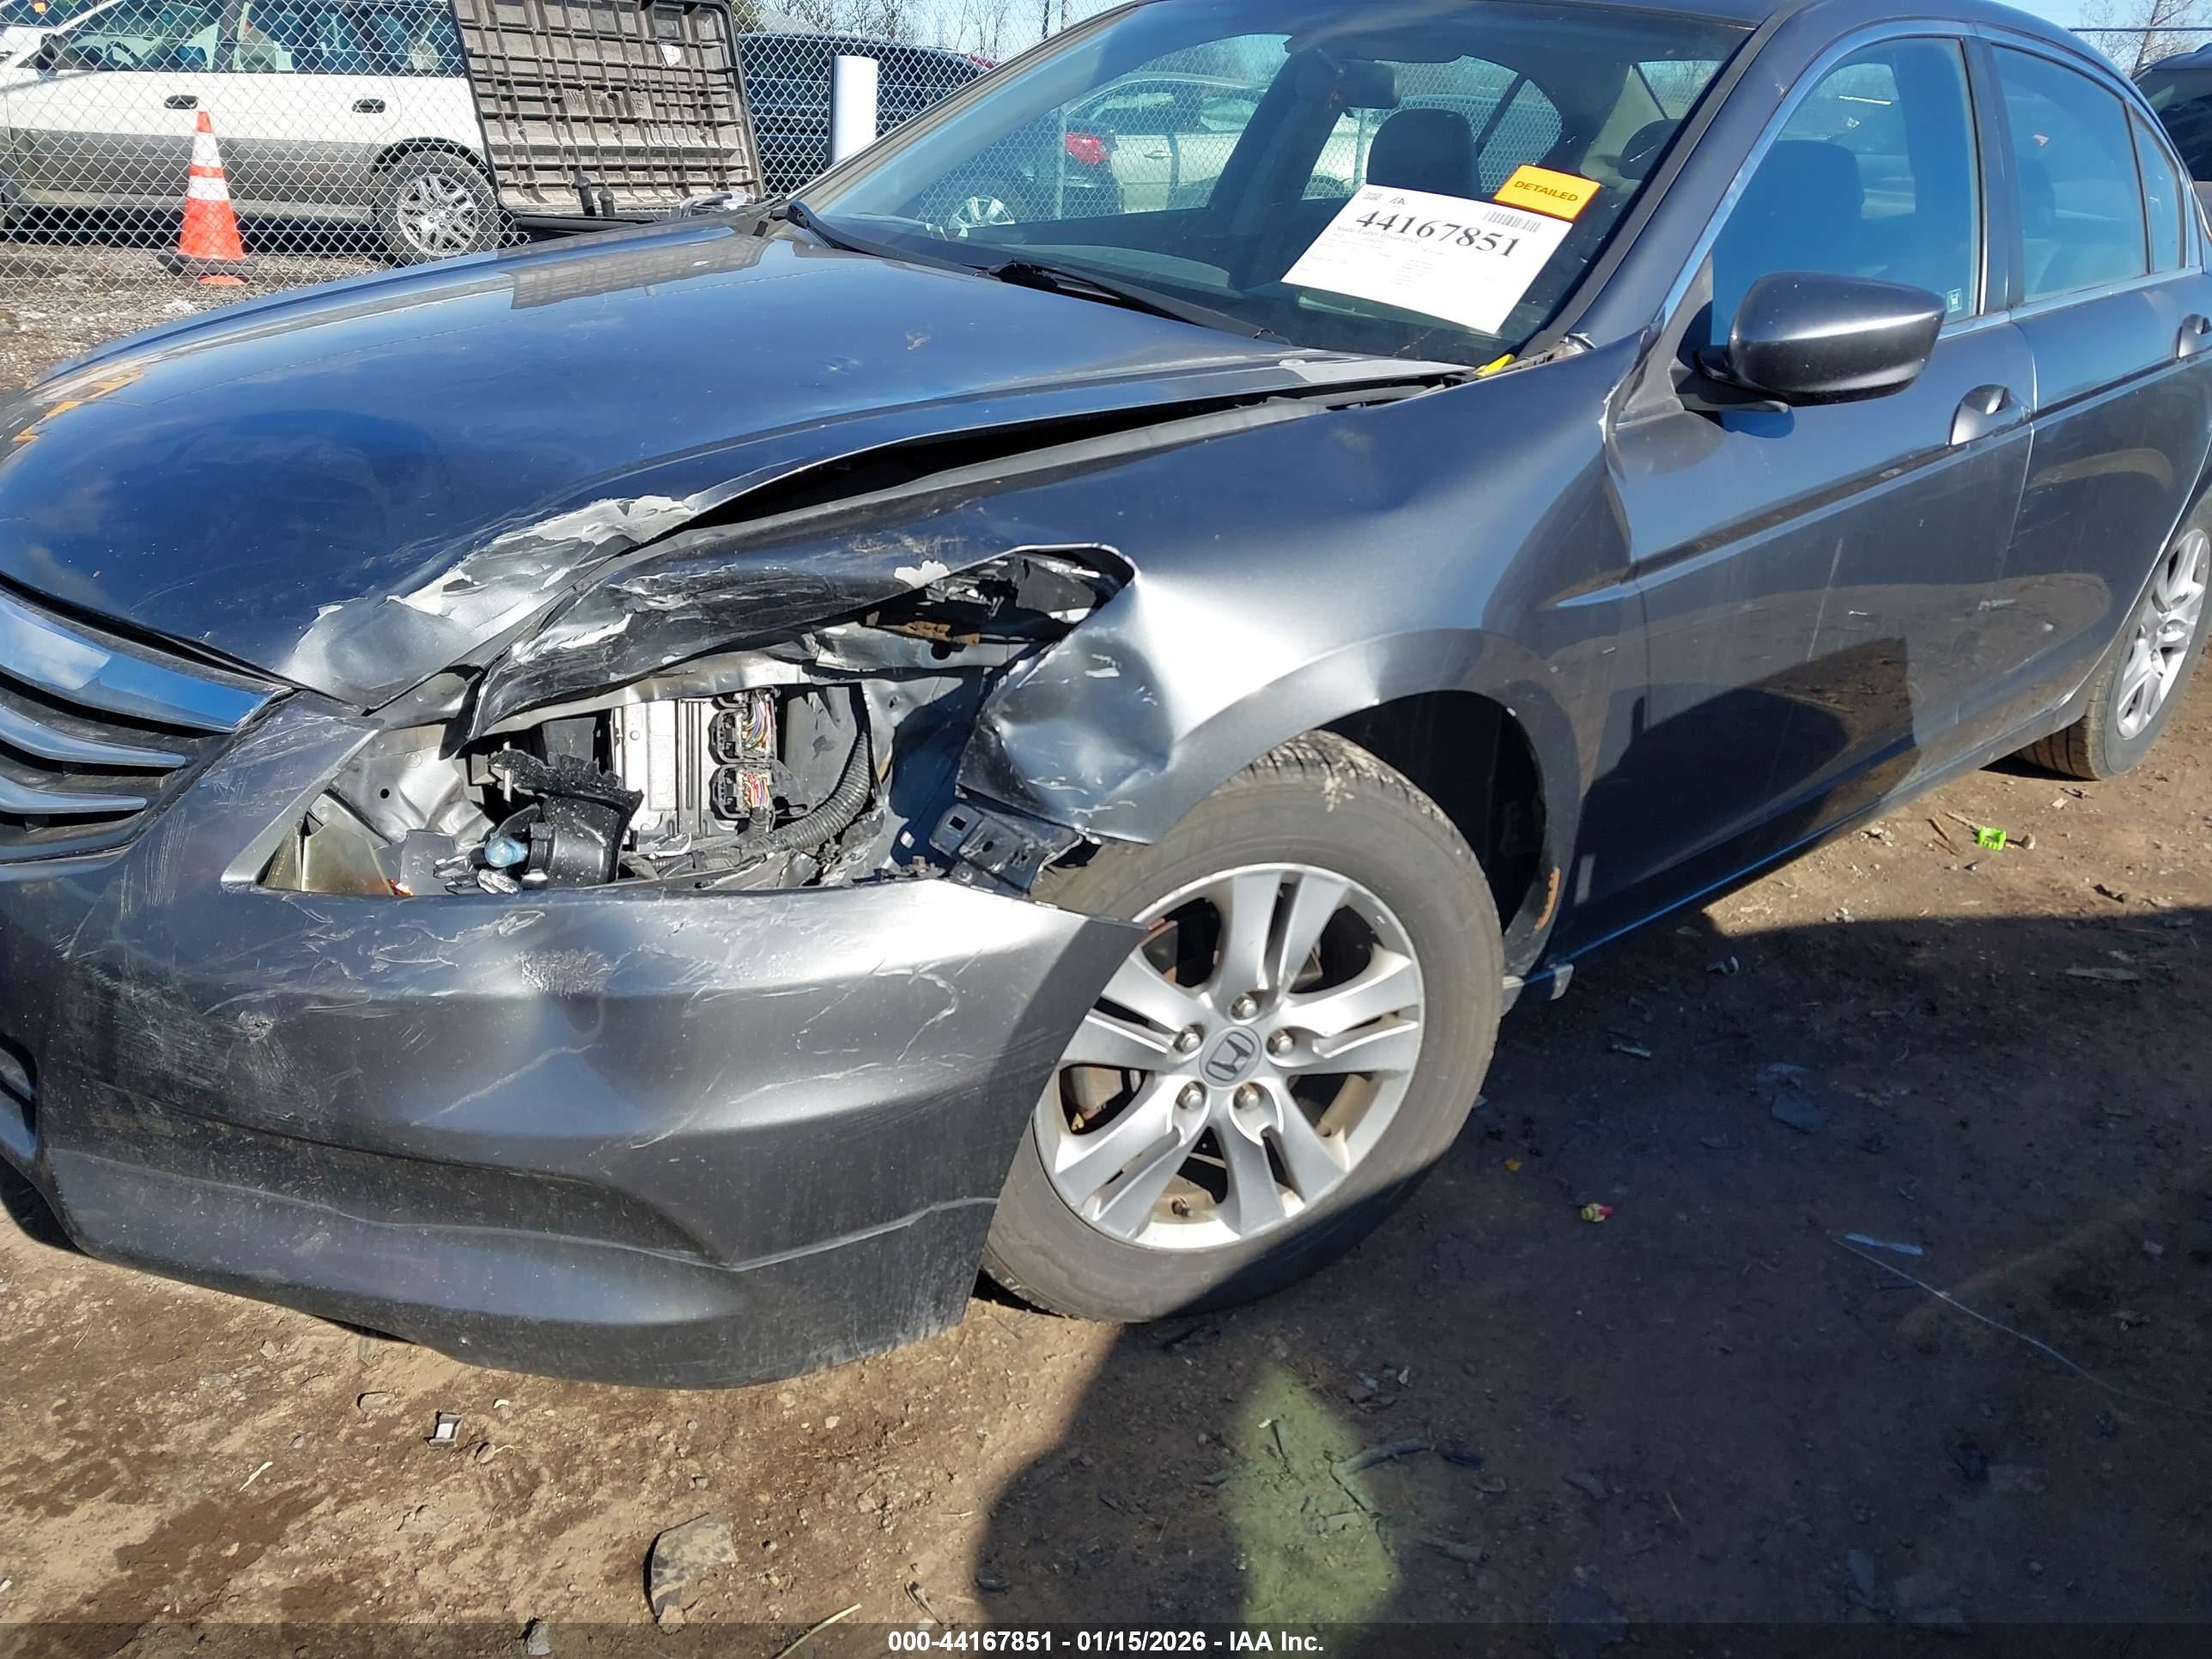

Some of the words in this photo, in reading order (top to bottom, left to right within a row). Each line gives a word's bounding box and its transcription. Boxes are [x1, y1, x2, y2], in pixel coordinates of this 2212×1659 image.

[1514, 180, 1579, 202] DETAILED
[1356, 210, 1521, 258] 44167851
[1358, 228, 1379, 237] Farm
